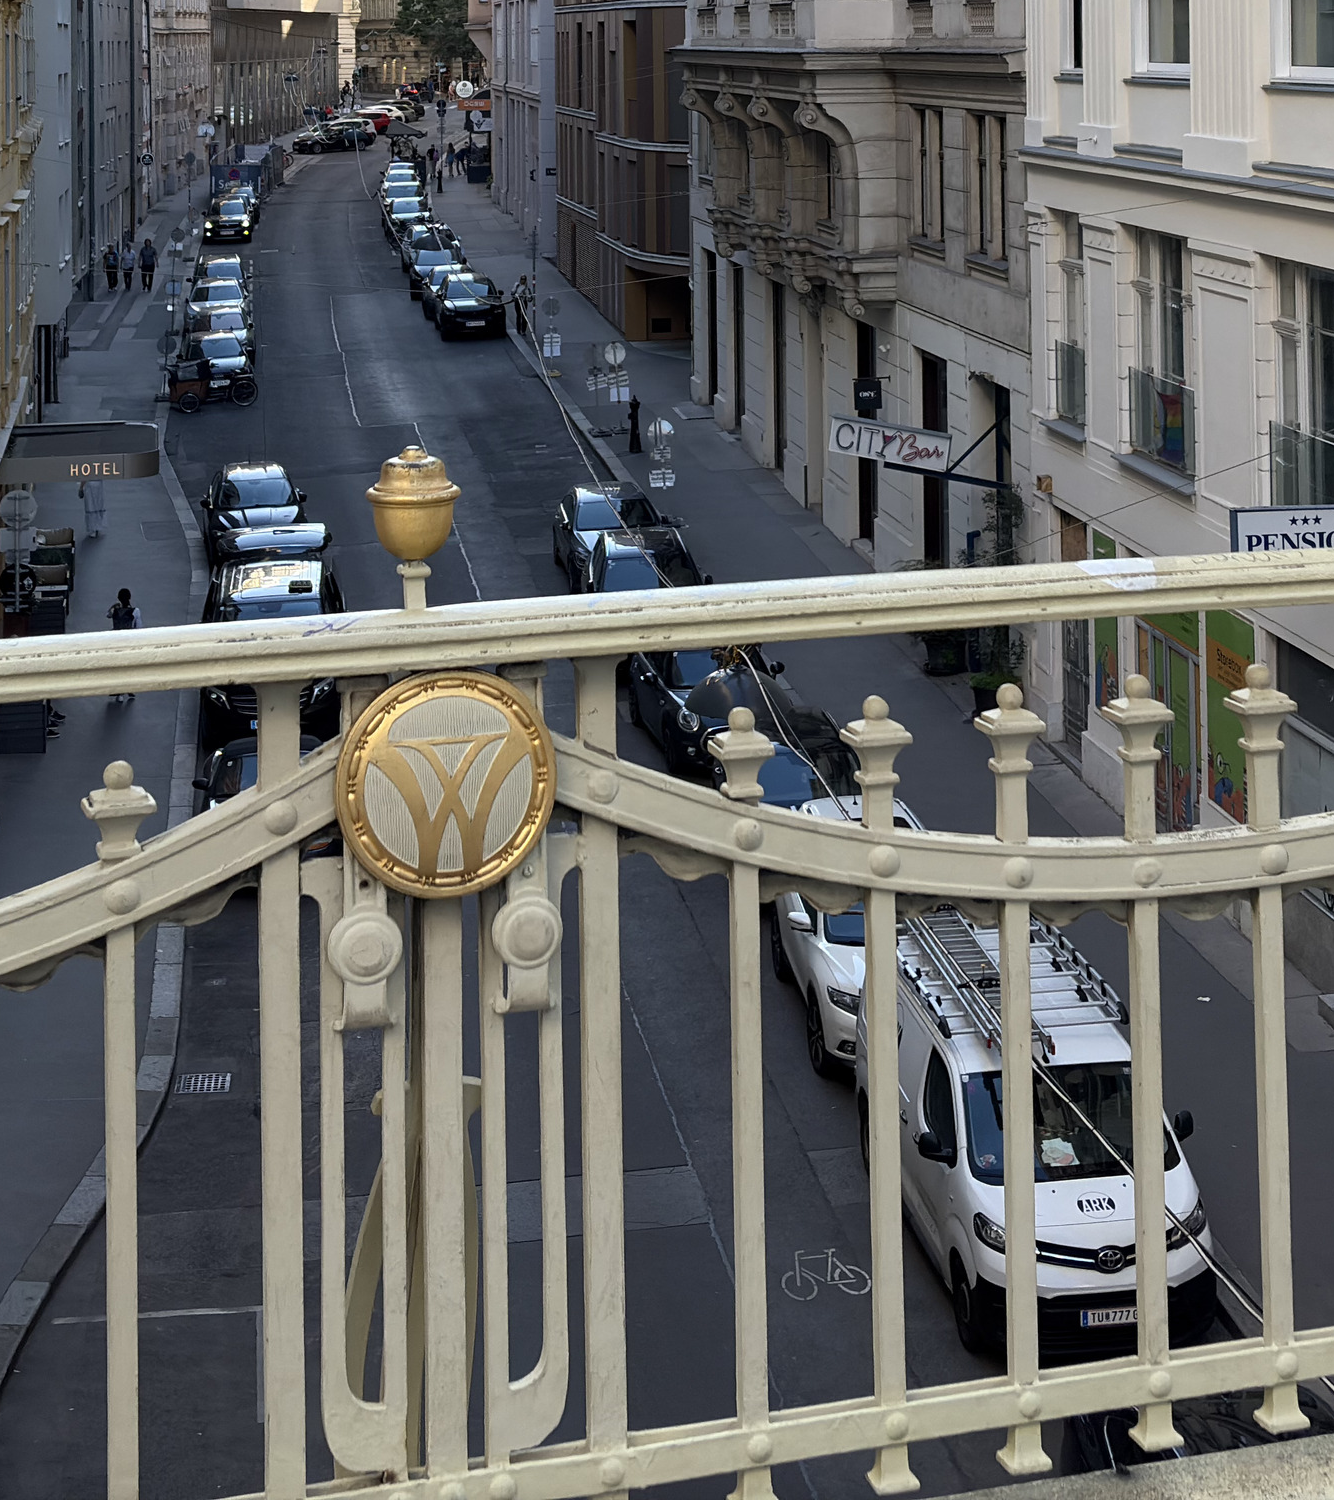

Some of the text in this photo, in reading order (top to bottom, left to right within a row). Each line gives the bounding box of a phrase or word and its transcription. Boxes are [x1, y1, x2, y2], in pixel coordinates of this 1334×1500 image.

[836, 423, 944, 463] CITY Bar
[70, 462, 121, 476] HOTEL
[1082, 1197, 1110, 1212] ARK
[1111, 1310, 1131, 1322] 777
